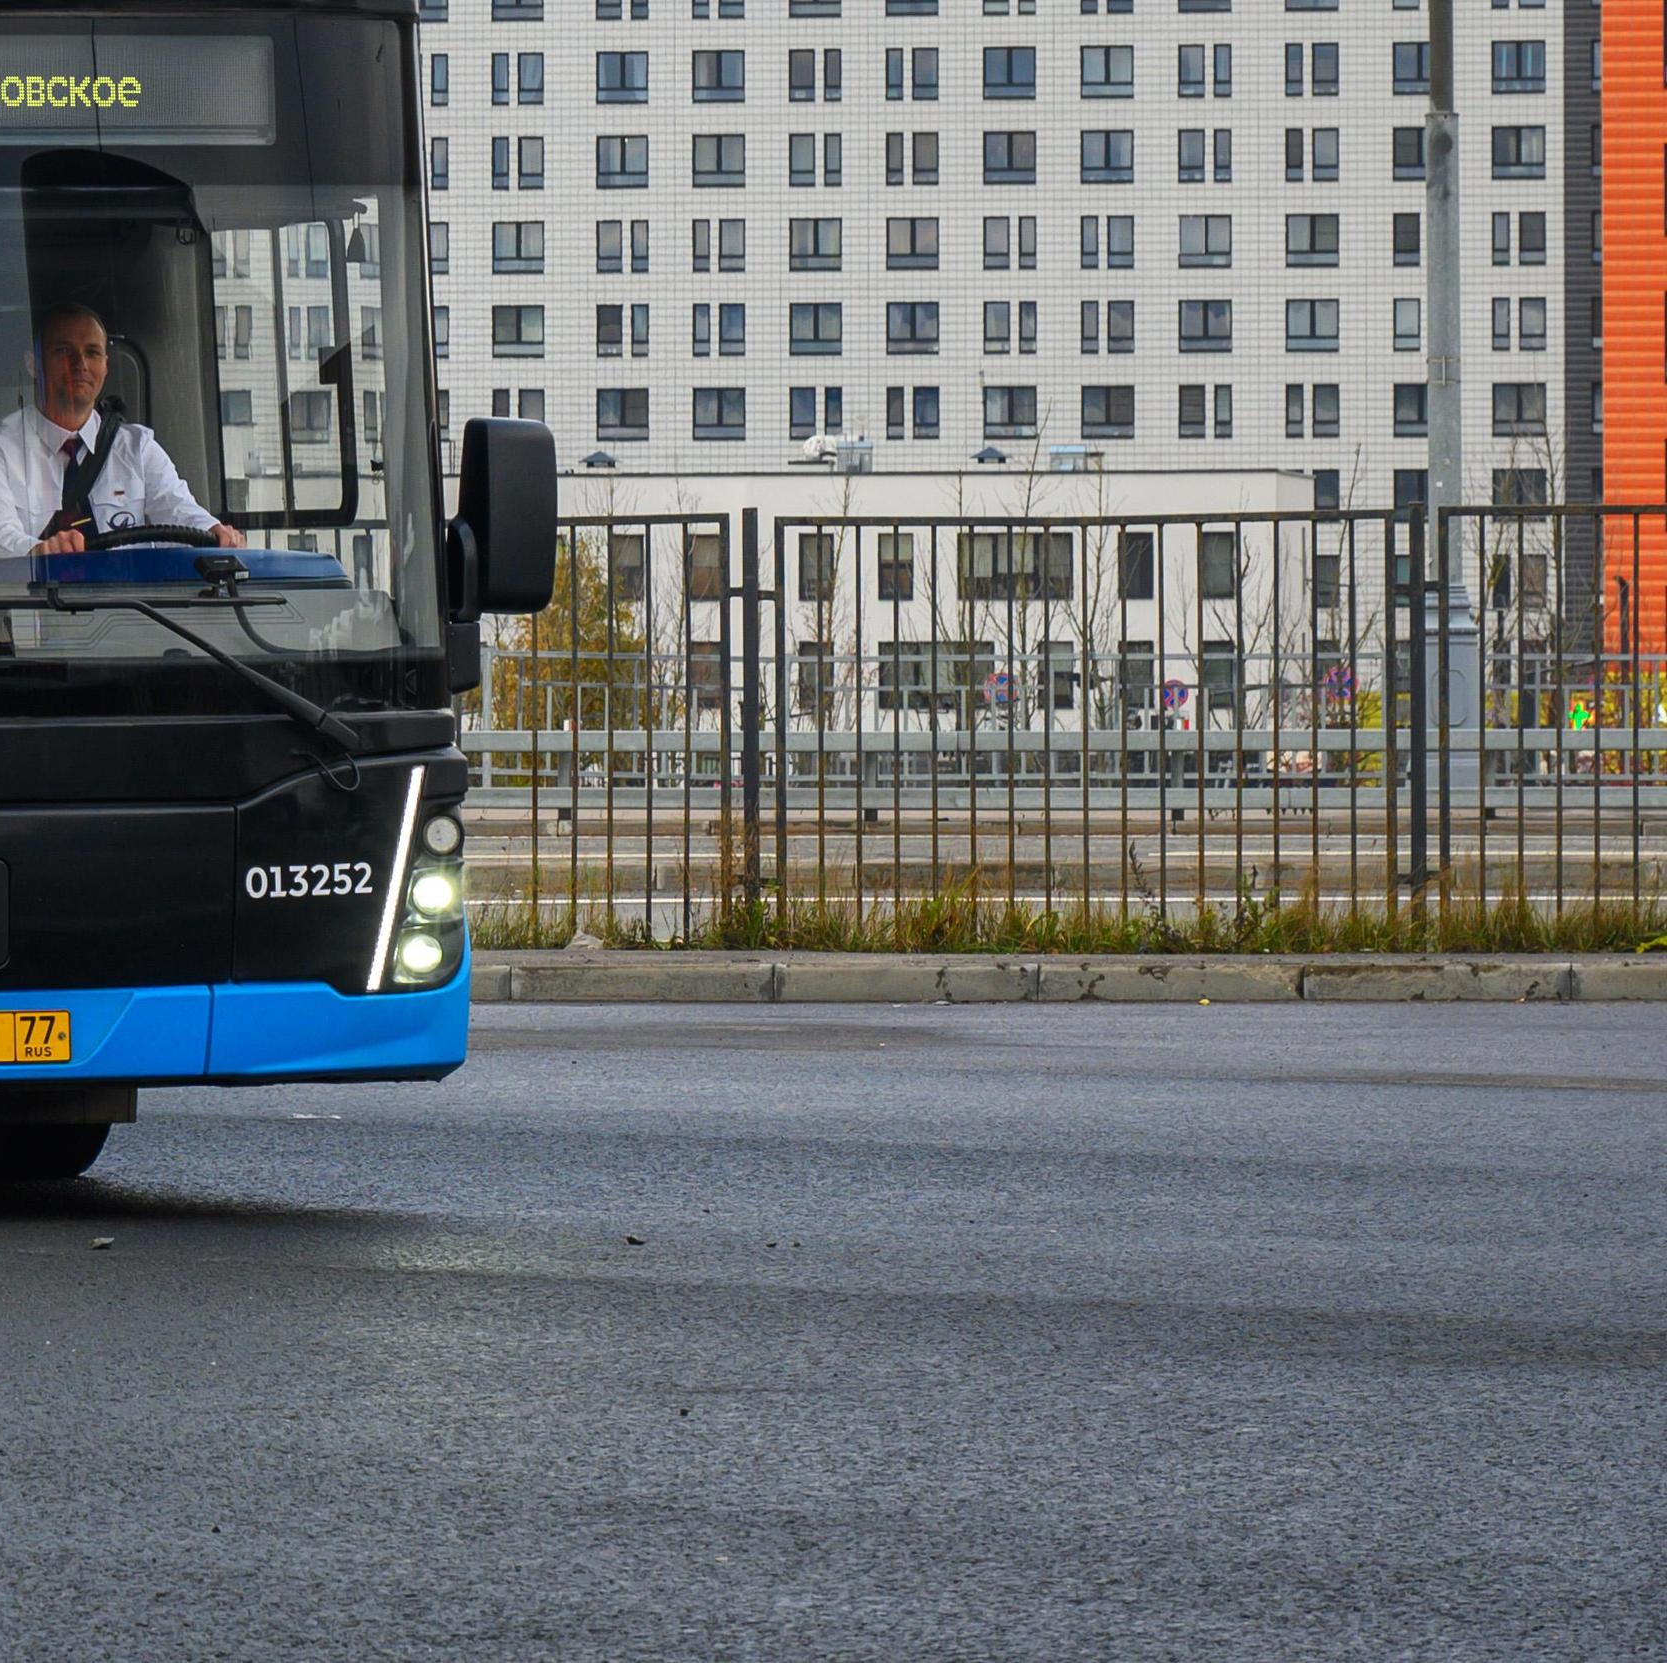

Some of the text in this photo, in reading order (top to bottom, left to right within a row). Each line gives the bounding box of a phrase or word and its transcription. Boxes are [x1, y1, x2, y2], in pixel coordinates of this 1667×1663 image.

[245, 862, 373, 899] 013252
[19, 1016, 56, 1045] 77
[24, 1046, 52, 1057] RUS
